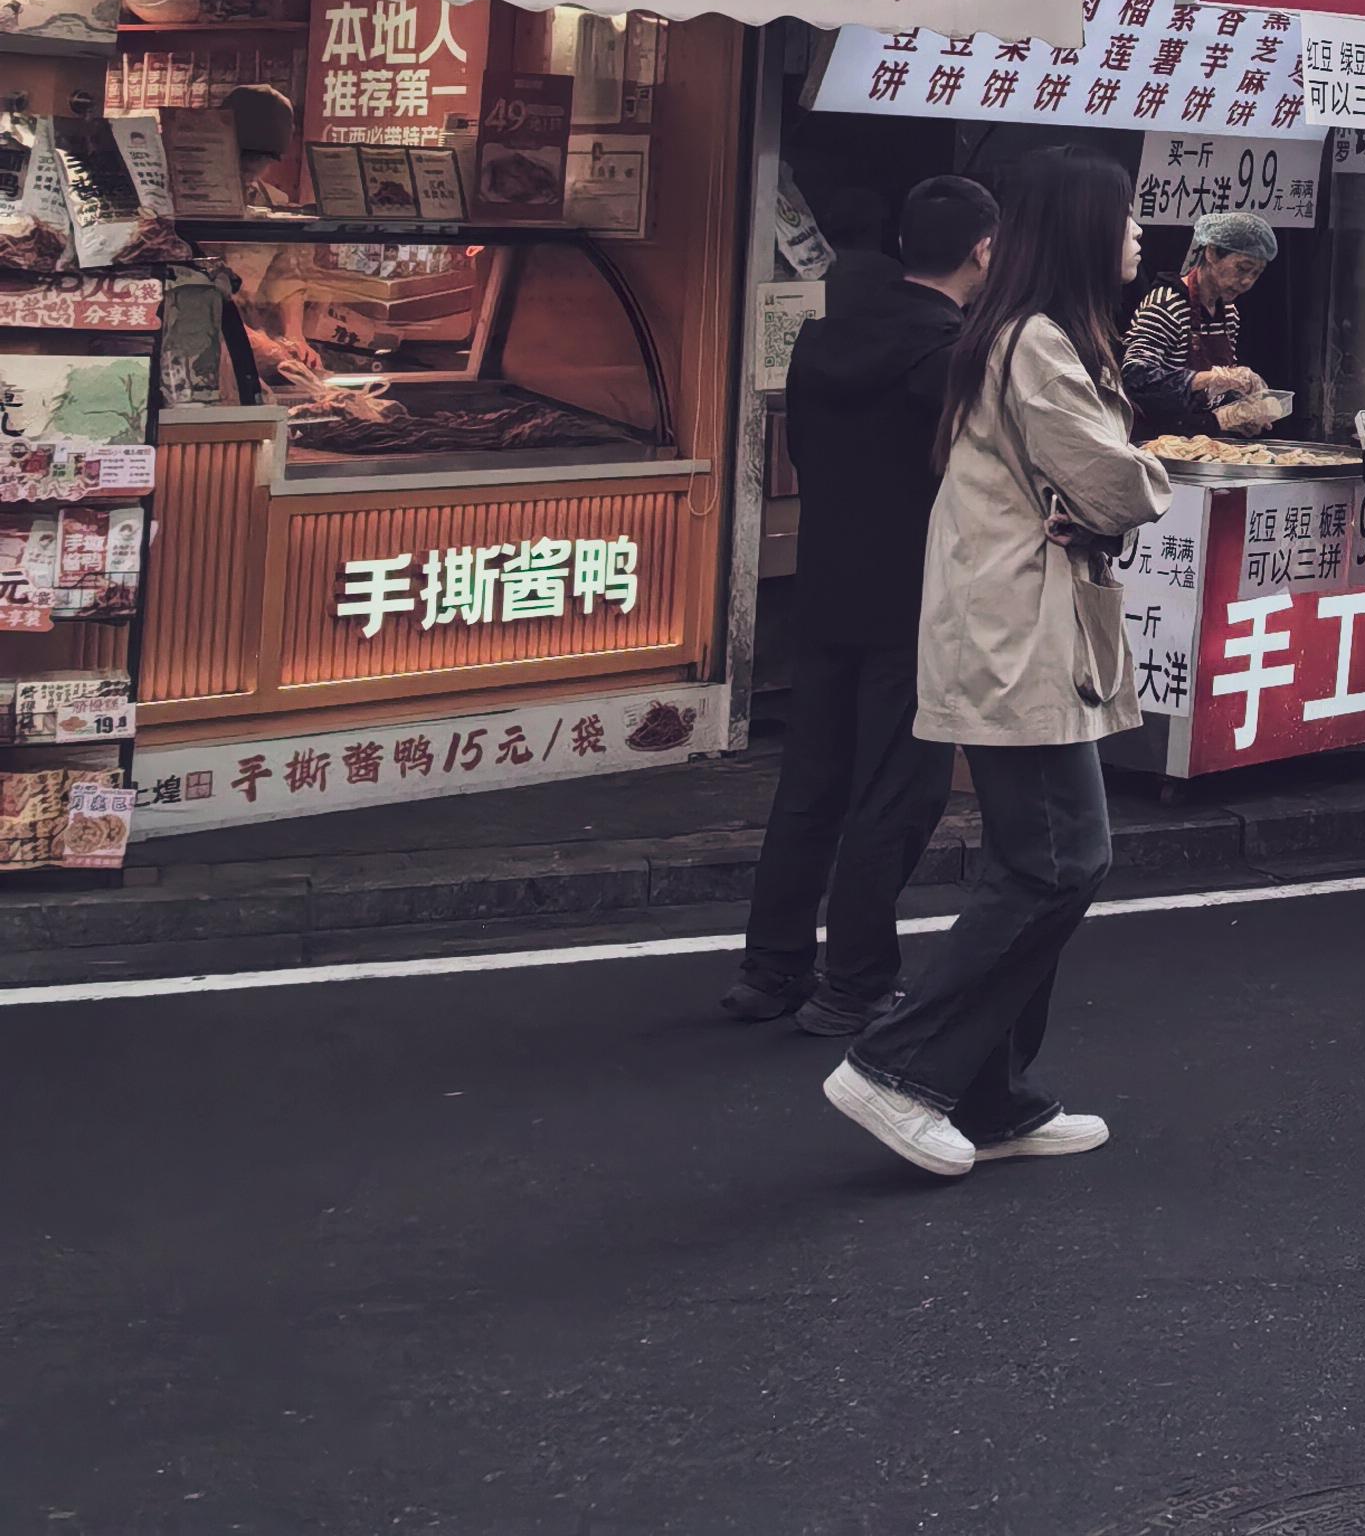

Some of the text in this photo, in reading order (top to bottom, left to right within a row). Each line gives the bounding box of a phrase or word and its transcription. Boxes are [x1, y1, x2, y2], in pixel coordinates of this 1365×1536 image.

[323, 1, 468, 64] 本地人
[1307, 39, 1332, 72] 红豆
[323, 69, 468, 118] 推荐第一
[1168, 140, 1214, 168] 买一斤
[1139, 173, 1232, 219] 省5个大洋
[84, 305, 148, 326] 分享装
[1249, 503, 1347, 544] 红豆 绿豆 板栗
[1161, 535, 1194, 561] 满满
[1247, 546, 1342, 586] 可以三拼
[337, 535, 639, 638] 手撕酱鸭
[1157, 568, 1195, 590] 一大盒
[231, 716, 607, 802] 手撕酱鸭15元/袋
